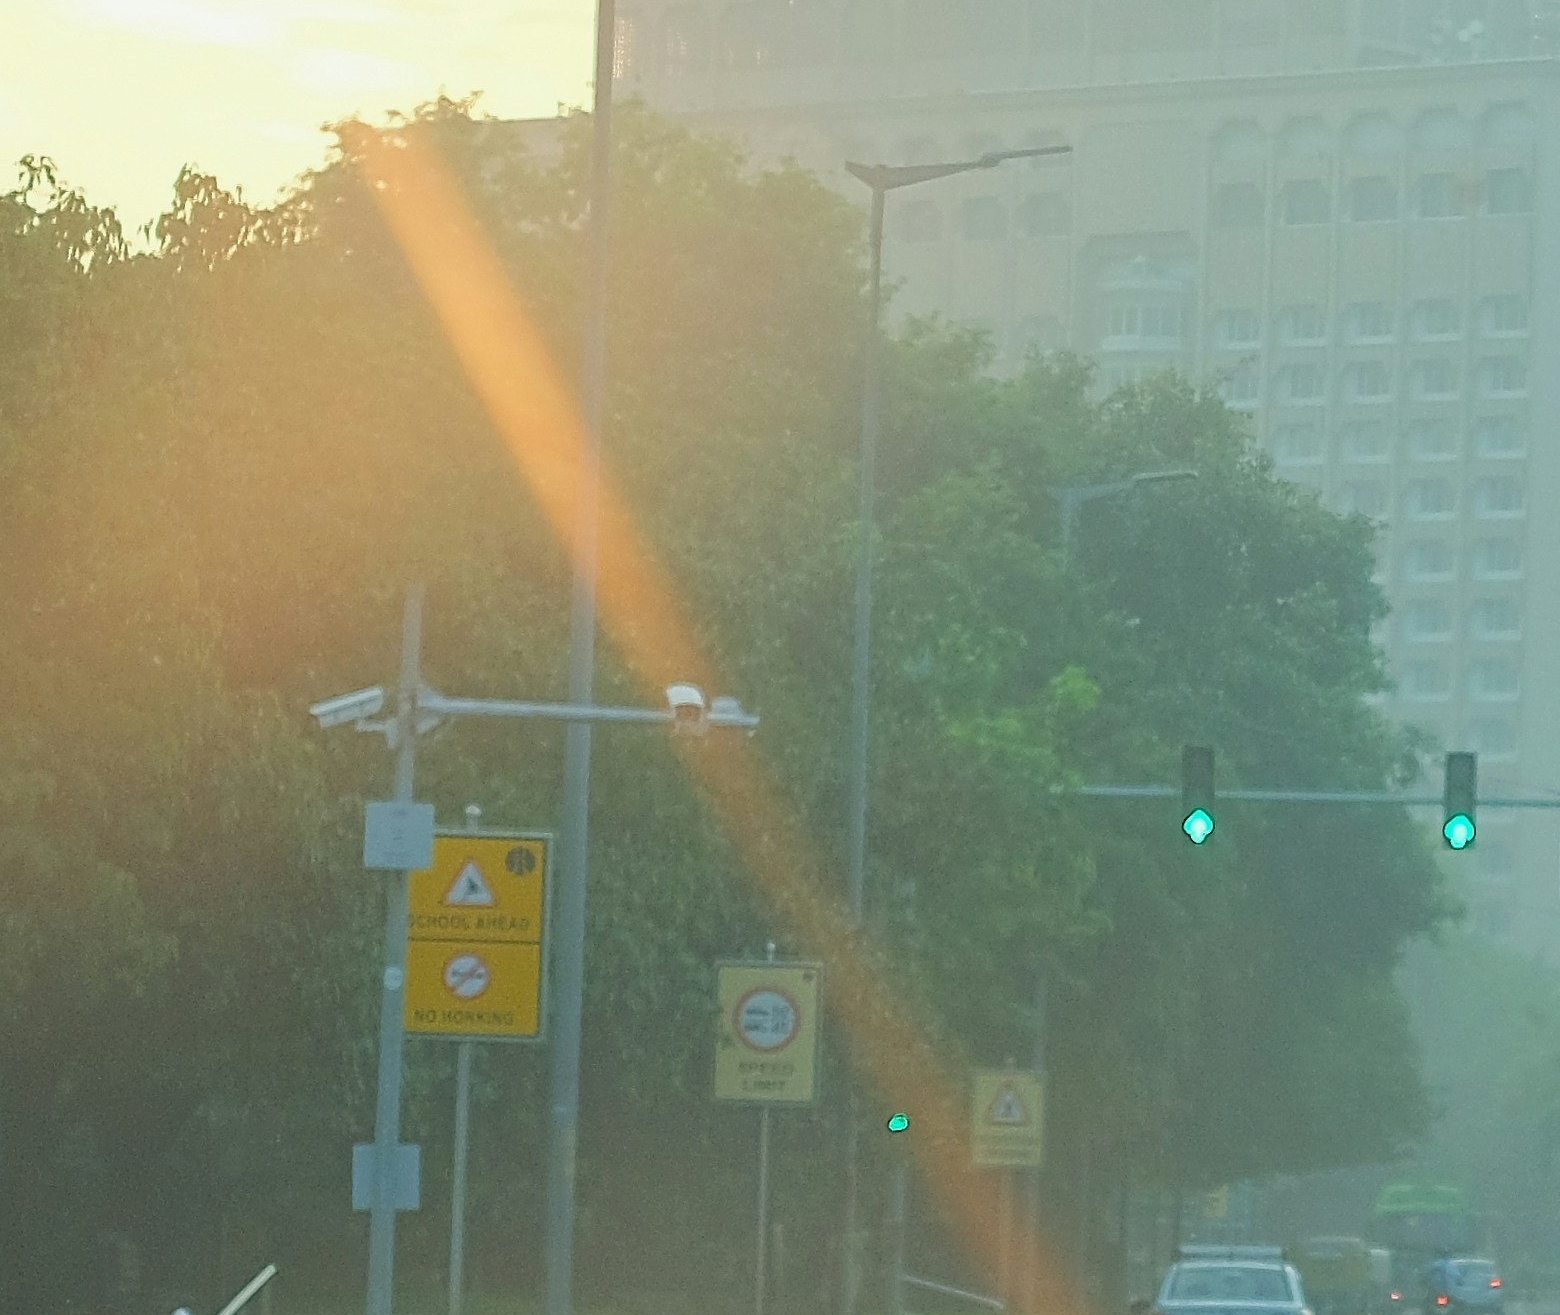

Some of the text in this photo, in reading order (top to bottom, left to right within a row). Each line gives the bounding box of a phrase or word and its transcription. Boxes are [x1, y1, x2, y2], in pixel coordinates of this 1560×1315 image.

[407, 914, 530, 932] SCHOOL AHEAD
[413, 1009, 514, 1026] NO HONKING
